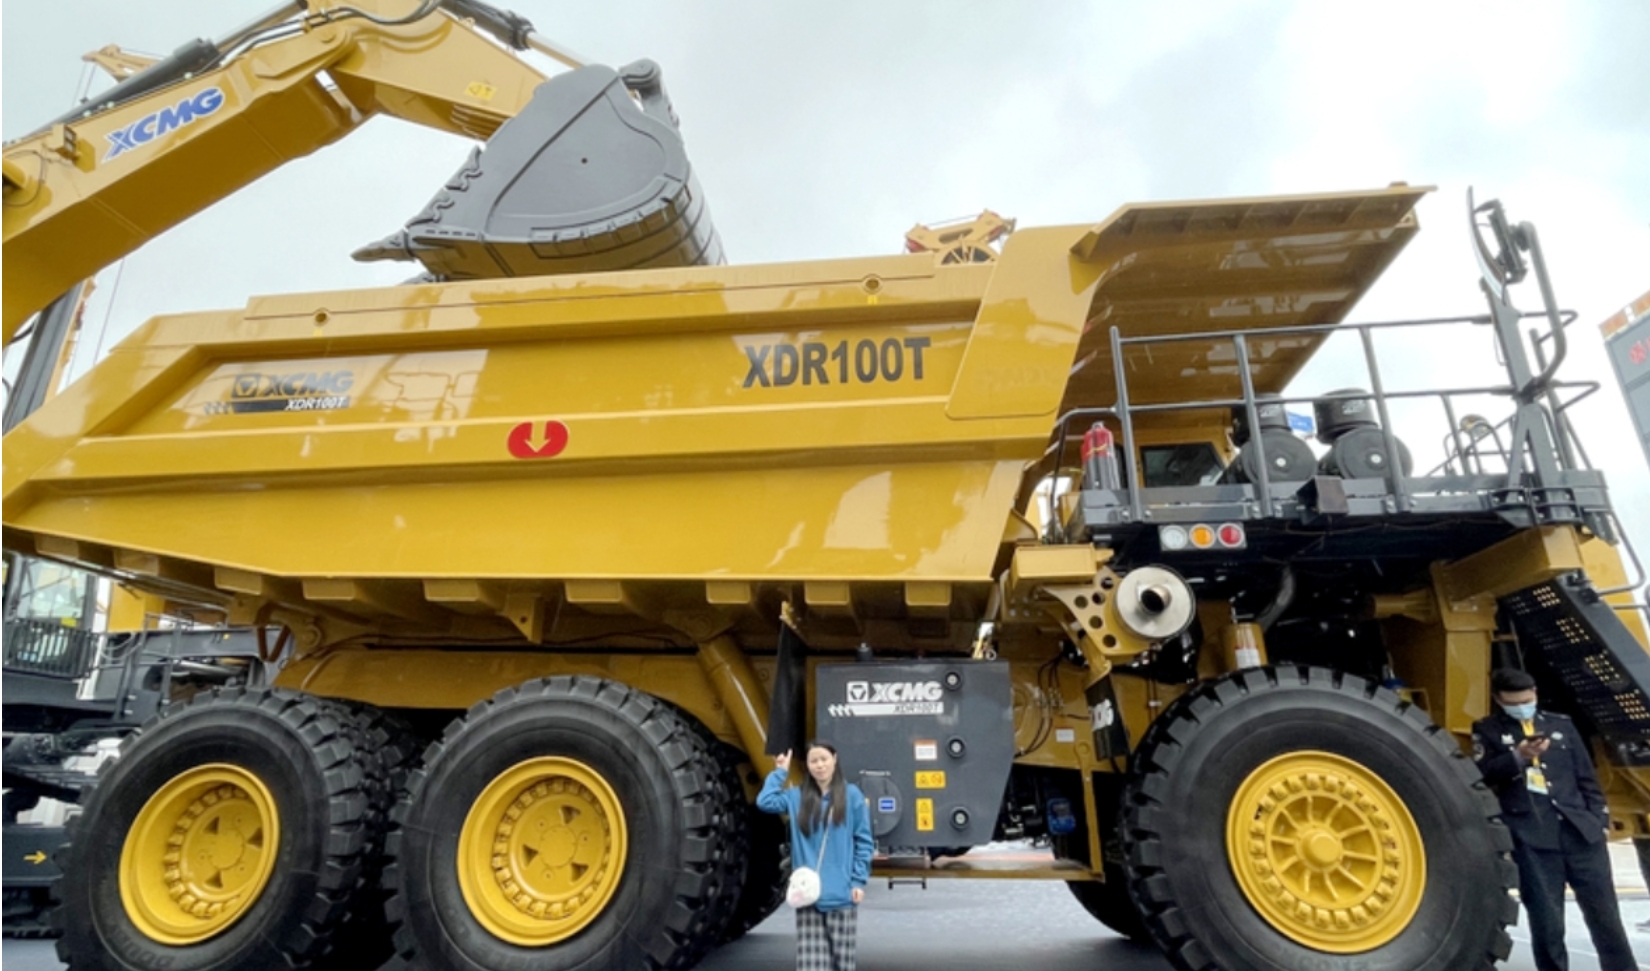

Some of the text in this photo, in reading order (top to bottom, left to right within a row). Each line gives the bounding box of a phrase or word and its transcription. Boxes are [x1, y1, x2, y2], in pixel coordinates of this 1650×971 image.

[102, 86, 225, 162] XCMG
[742, 336, 932, 388] XDR100T
[263, 371, 354, 396] XCMG
[285, 396, 345, 411] XDR100T
[869, 681, 944, 702] XCMG
